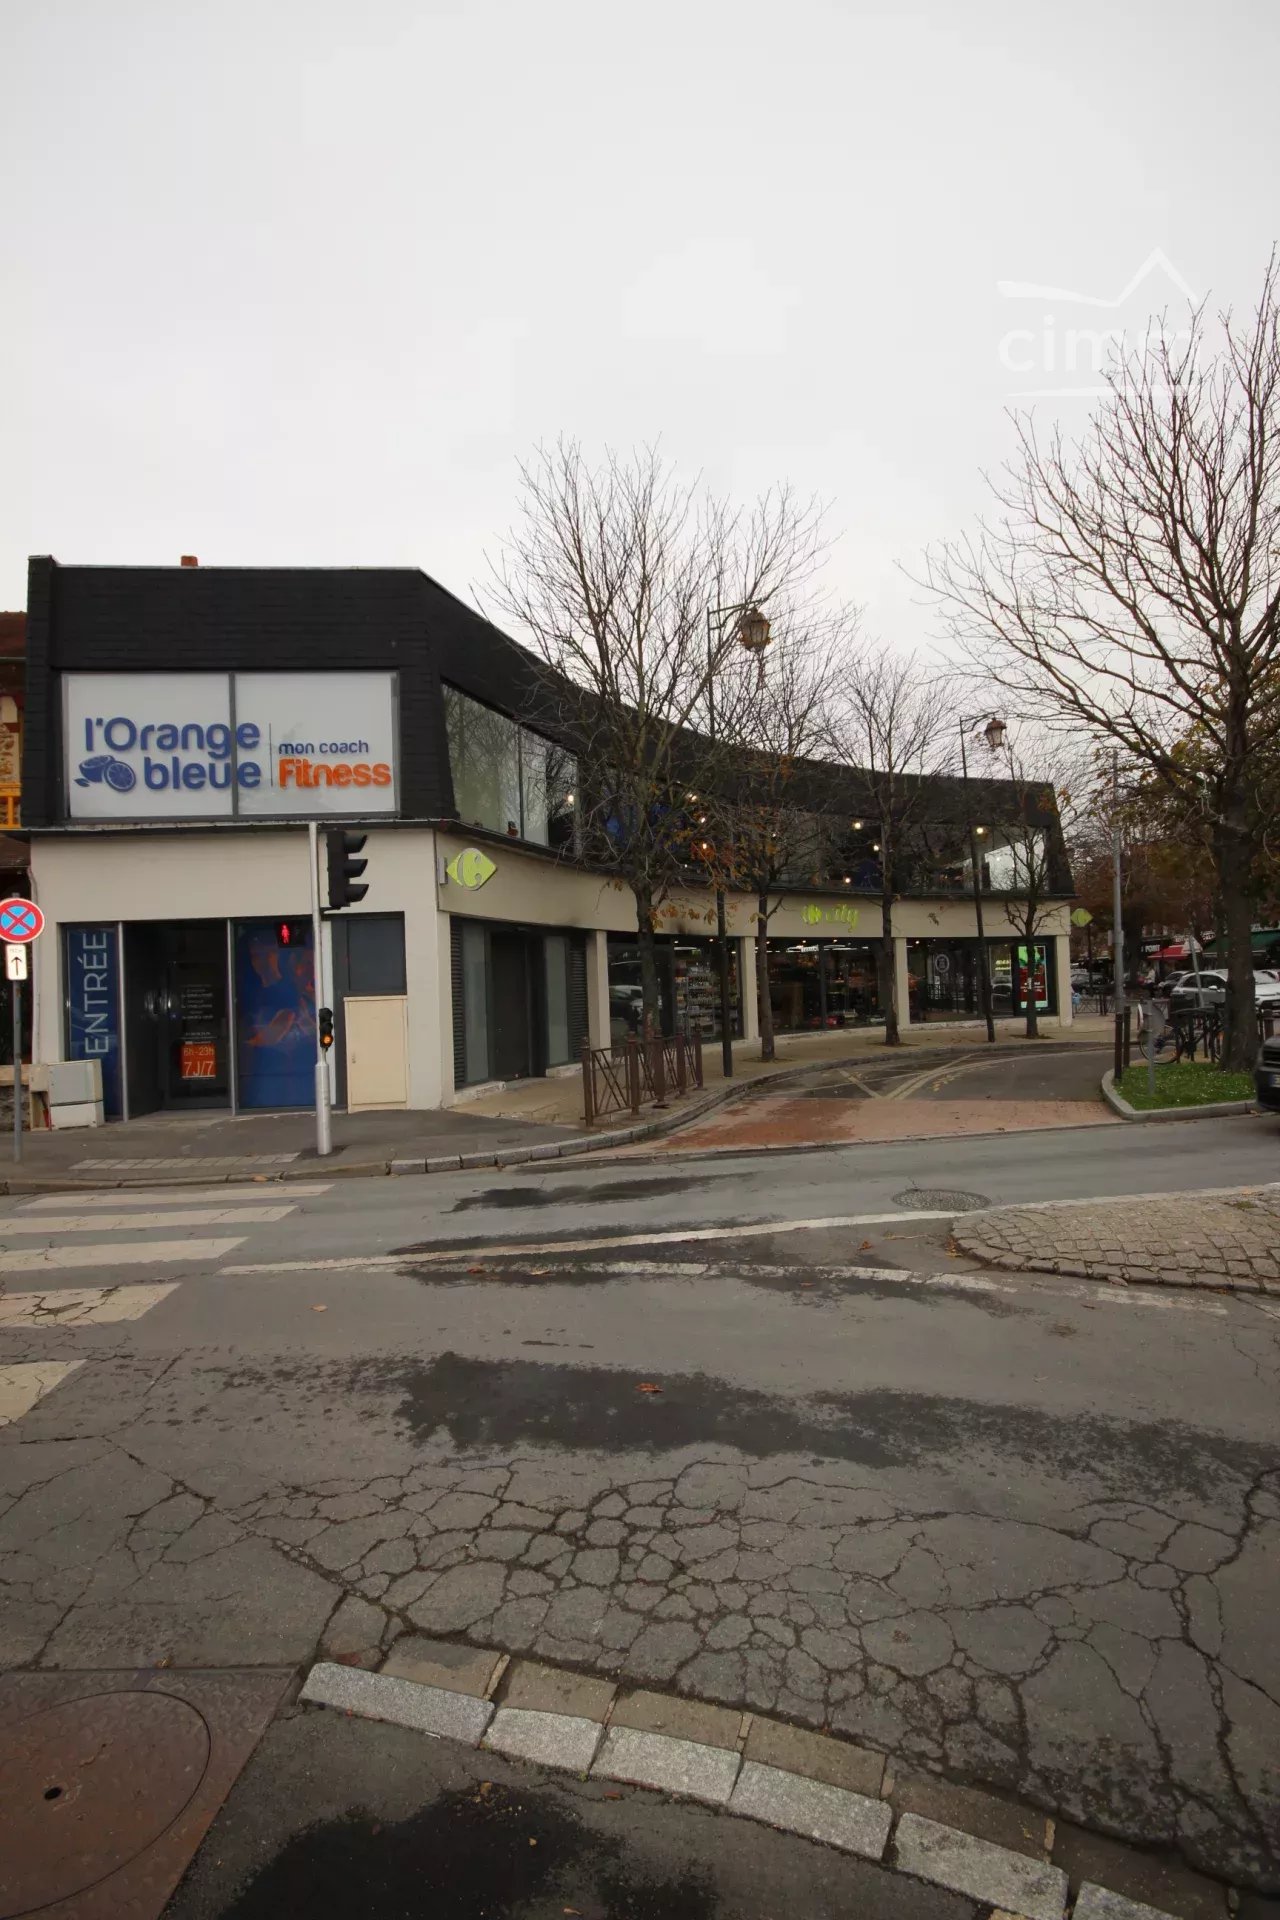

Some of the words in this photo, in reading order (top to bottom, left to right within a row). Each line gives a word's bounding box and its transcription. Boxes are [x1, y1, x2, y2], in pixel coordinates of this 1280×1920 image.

[85, 717, 260, 759] l'Orange
[278, 742, 315, 755] mon
[318, 739, 369, 755] coach
[143, 756, 261, 790] bleue
[278, 758, 392, 790] Fitness
[77, 932, 109, 1054] ENTRÉE
